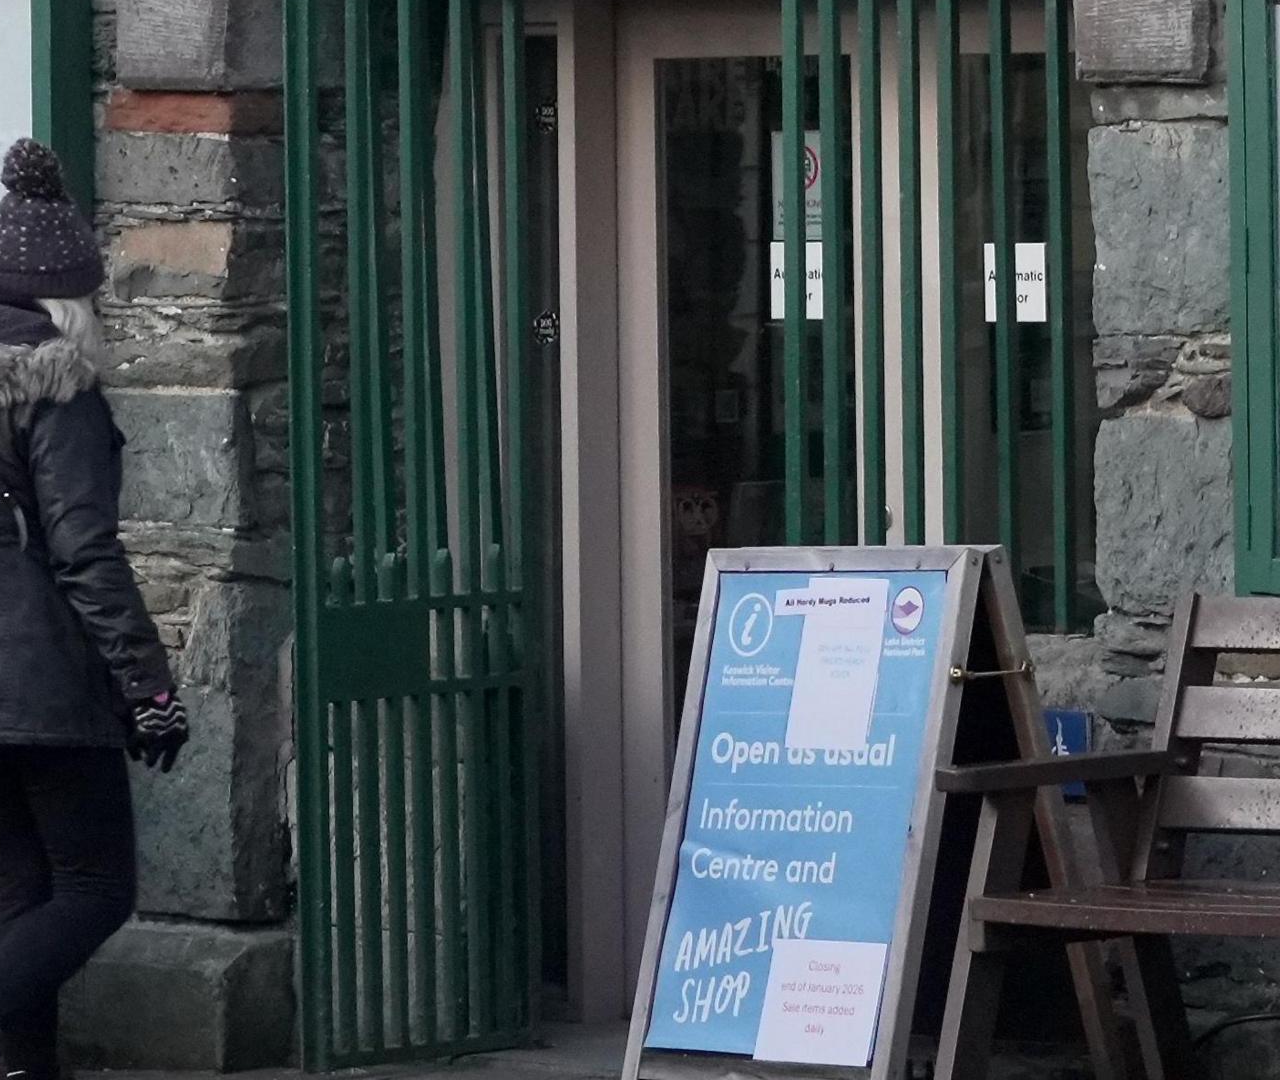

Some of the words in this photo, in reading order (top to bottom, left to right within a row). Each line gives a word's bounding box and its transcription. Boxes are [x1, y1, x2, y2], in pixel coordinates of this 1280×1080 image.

[819, 597, 837, 606] Mugs
[839, 596, 871, 605] Reduced
[901, 637, 925, 645] District
[883, 647, 909, 656] National
[911, 647, 925, 656] Park
[723, 664, 754, 675] Keswick
[755, 664, 781, 674] Visitor
[722, 675, 767, 687] Information
[711, 732, 780, 774] Open
[787, 746, 817, 766] as
[824, 733, 896, 767] usual
[699, 798, 853, 833] Information
[691, 847, 779, 883] Centre
[786, 852, 837, 884] and
[675, 901, 813, 972] AMAZING
[809, 960, 840, 975] Closing
[782, 982, 796, 992] end
[797, 981, 807, 992] of
[807, 982, 840, 994] January
[841, 984, 864, 994] 2026
[673, 971, 751, 1024] SHOP
[783, 1001, 800, 1013] Sale
[802, 1003, 825, 1014] items
[827, 1004, 855, 1016] added
[804, 1022, 824, 1035] daily
